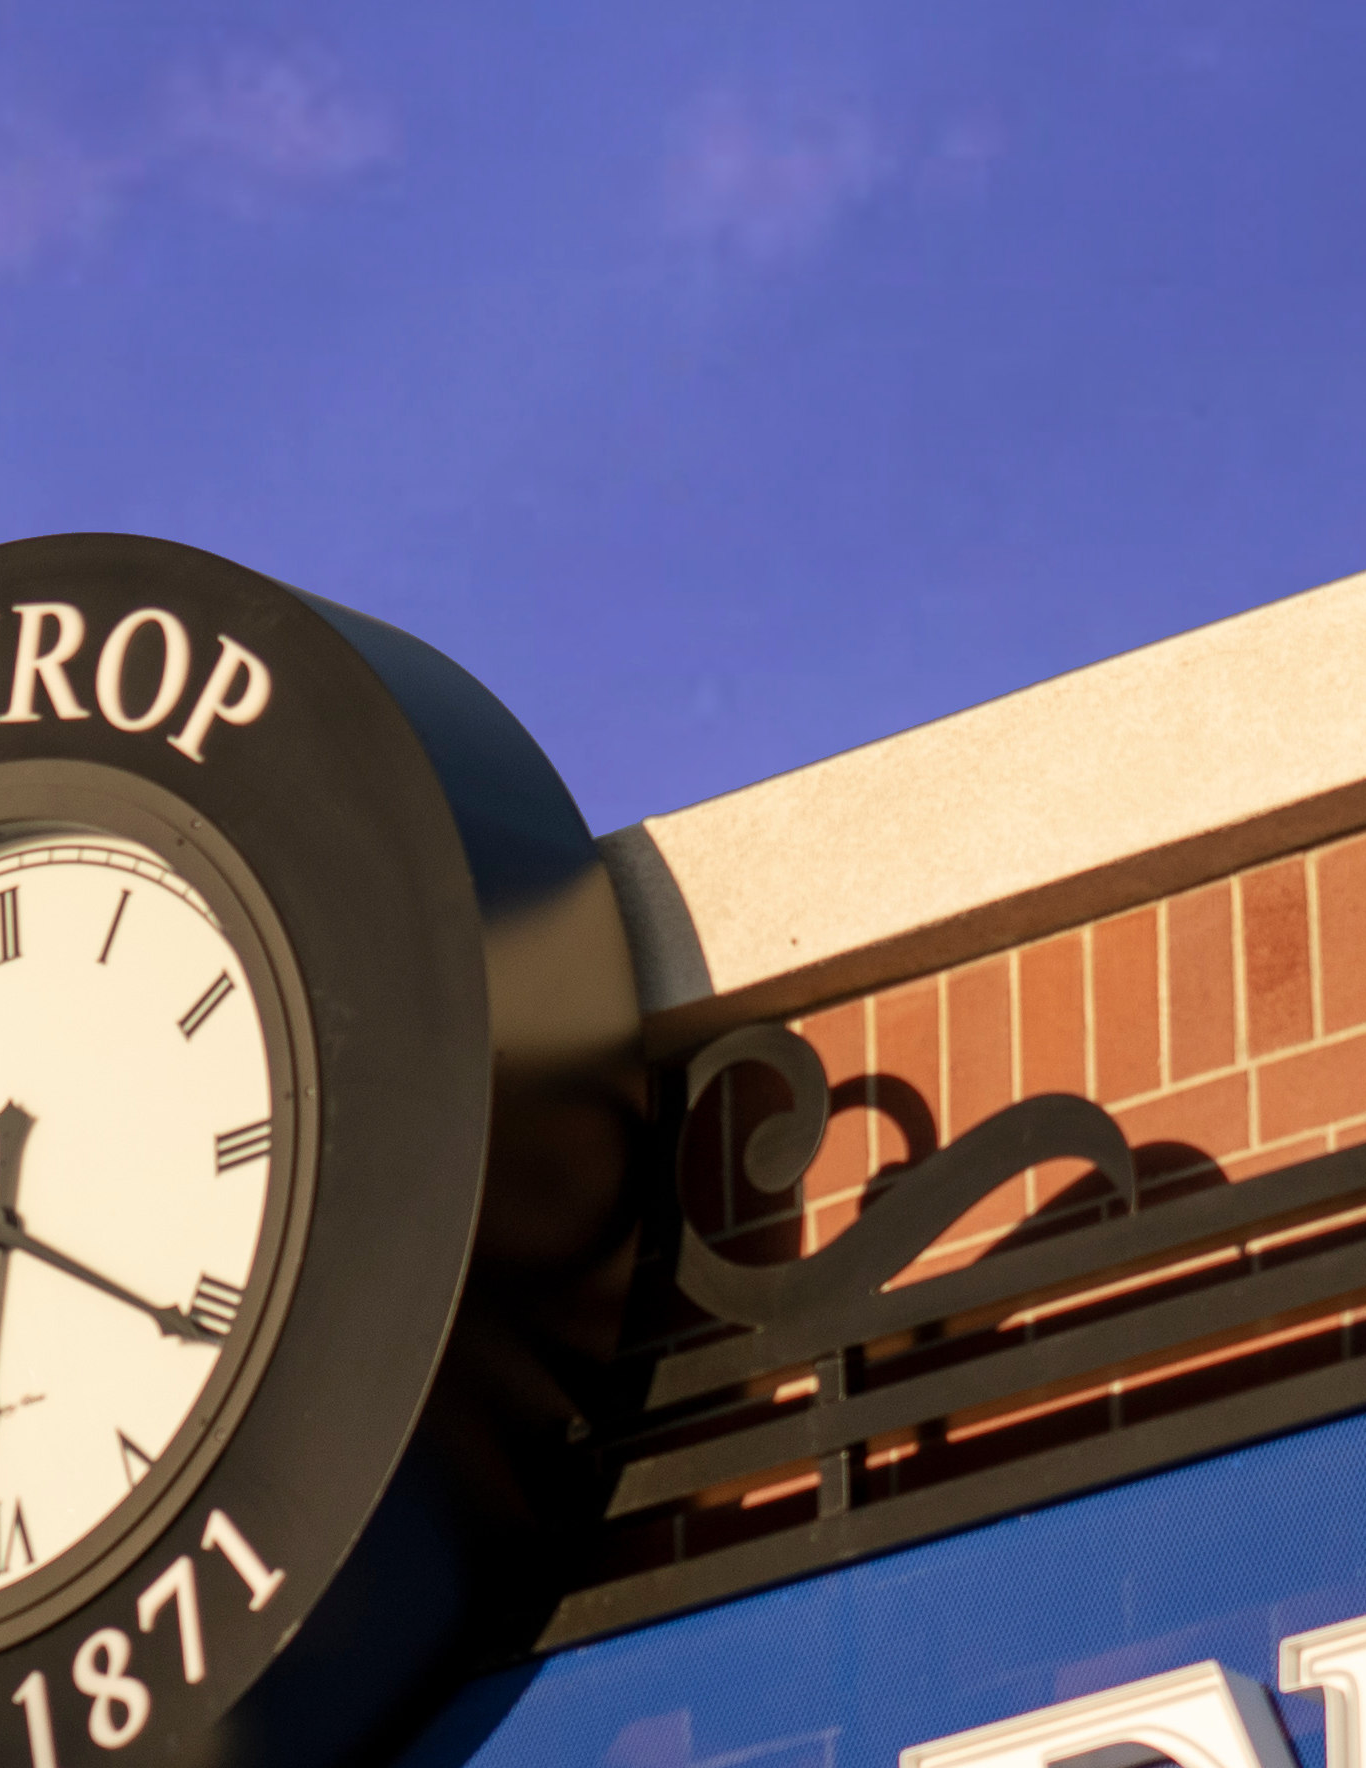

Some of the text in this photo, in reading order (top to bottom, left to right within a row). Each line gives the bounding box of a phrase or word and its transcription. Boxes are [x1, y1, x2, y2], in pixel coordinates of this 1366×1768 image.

[98, 889, 133, 965] I
[177, 970, 236, 1042] II
[214, 1117, 272, 1175] III
